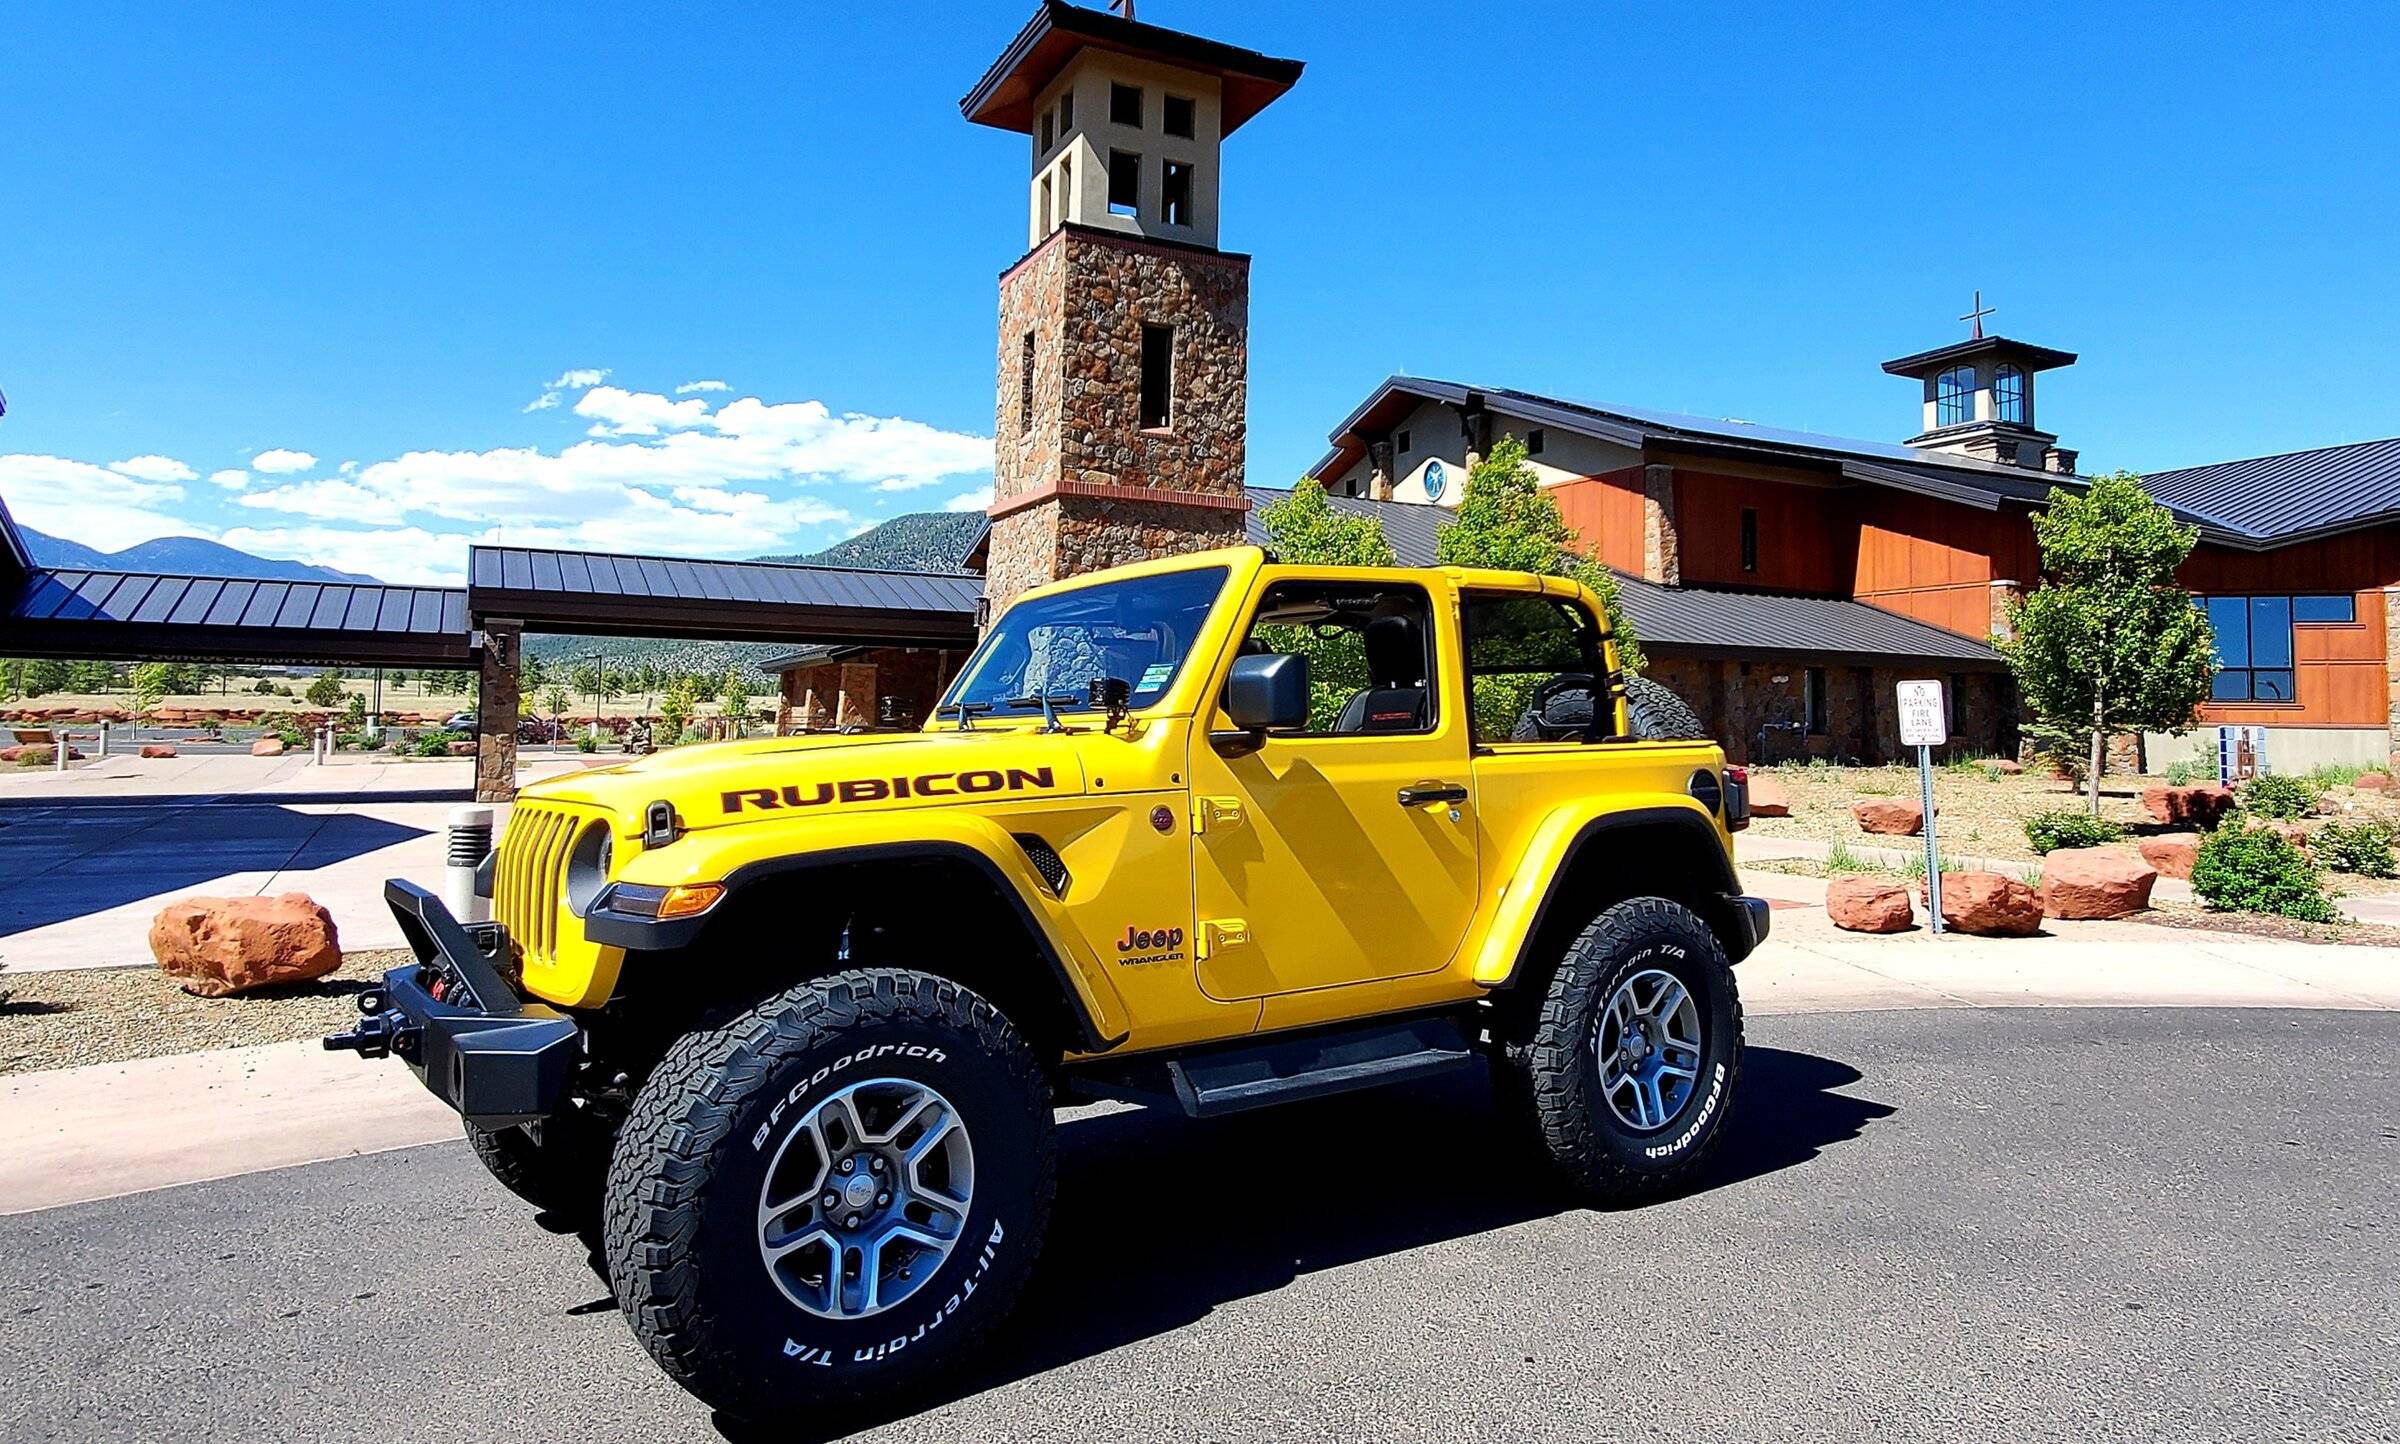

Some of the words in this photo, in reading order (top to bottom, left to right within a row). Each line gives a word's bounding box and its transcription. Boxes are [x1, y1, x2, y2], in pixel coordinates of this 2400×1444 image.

[1914, 687, 1926, 697] NO
[1903, 697, 1938, 708] PARKING
[1911, 718, 1933, 727] LANE
[1912, 709, 1930, 718] FIRE
[720, 766, 1055, 814] RUBICON
[1117, 926, 1184, 952] Jeep
[1118, 952, 1184, 966] WRANGLER
[1660, 944, 1686, 959] T/A
[752, 1042, 947, 1151] BFGoodrich
[1645, 1062, 1726, 1159] BFGoodrich
[854, 1218, 1004, 1363] All-Terrain
[783, 1337, 832, 1366] T/A
